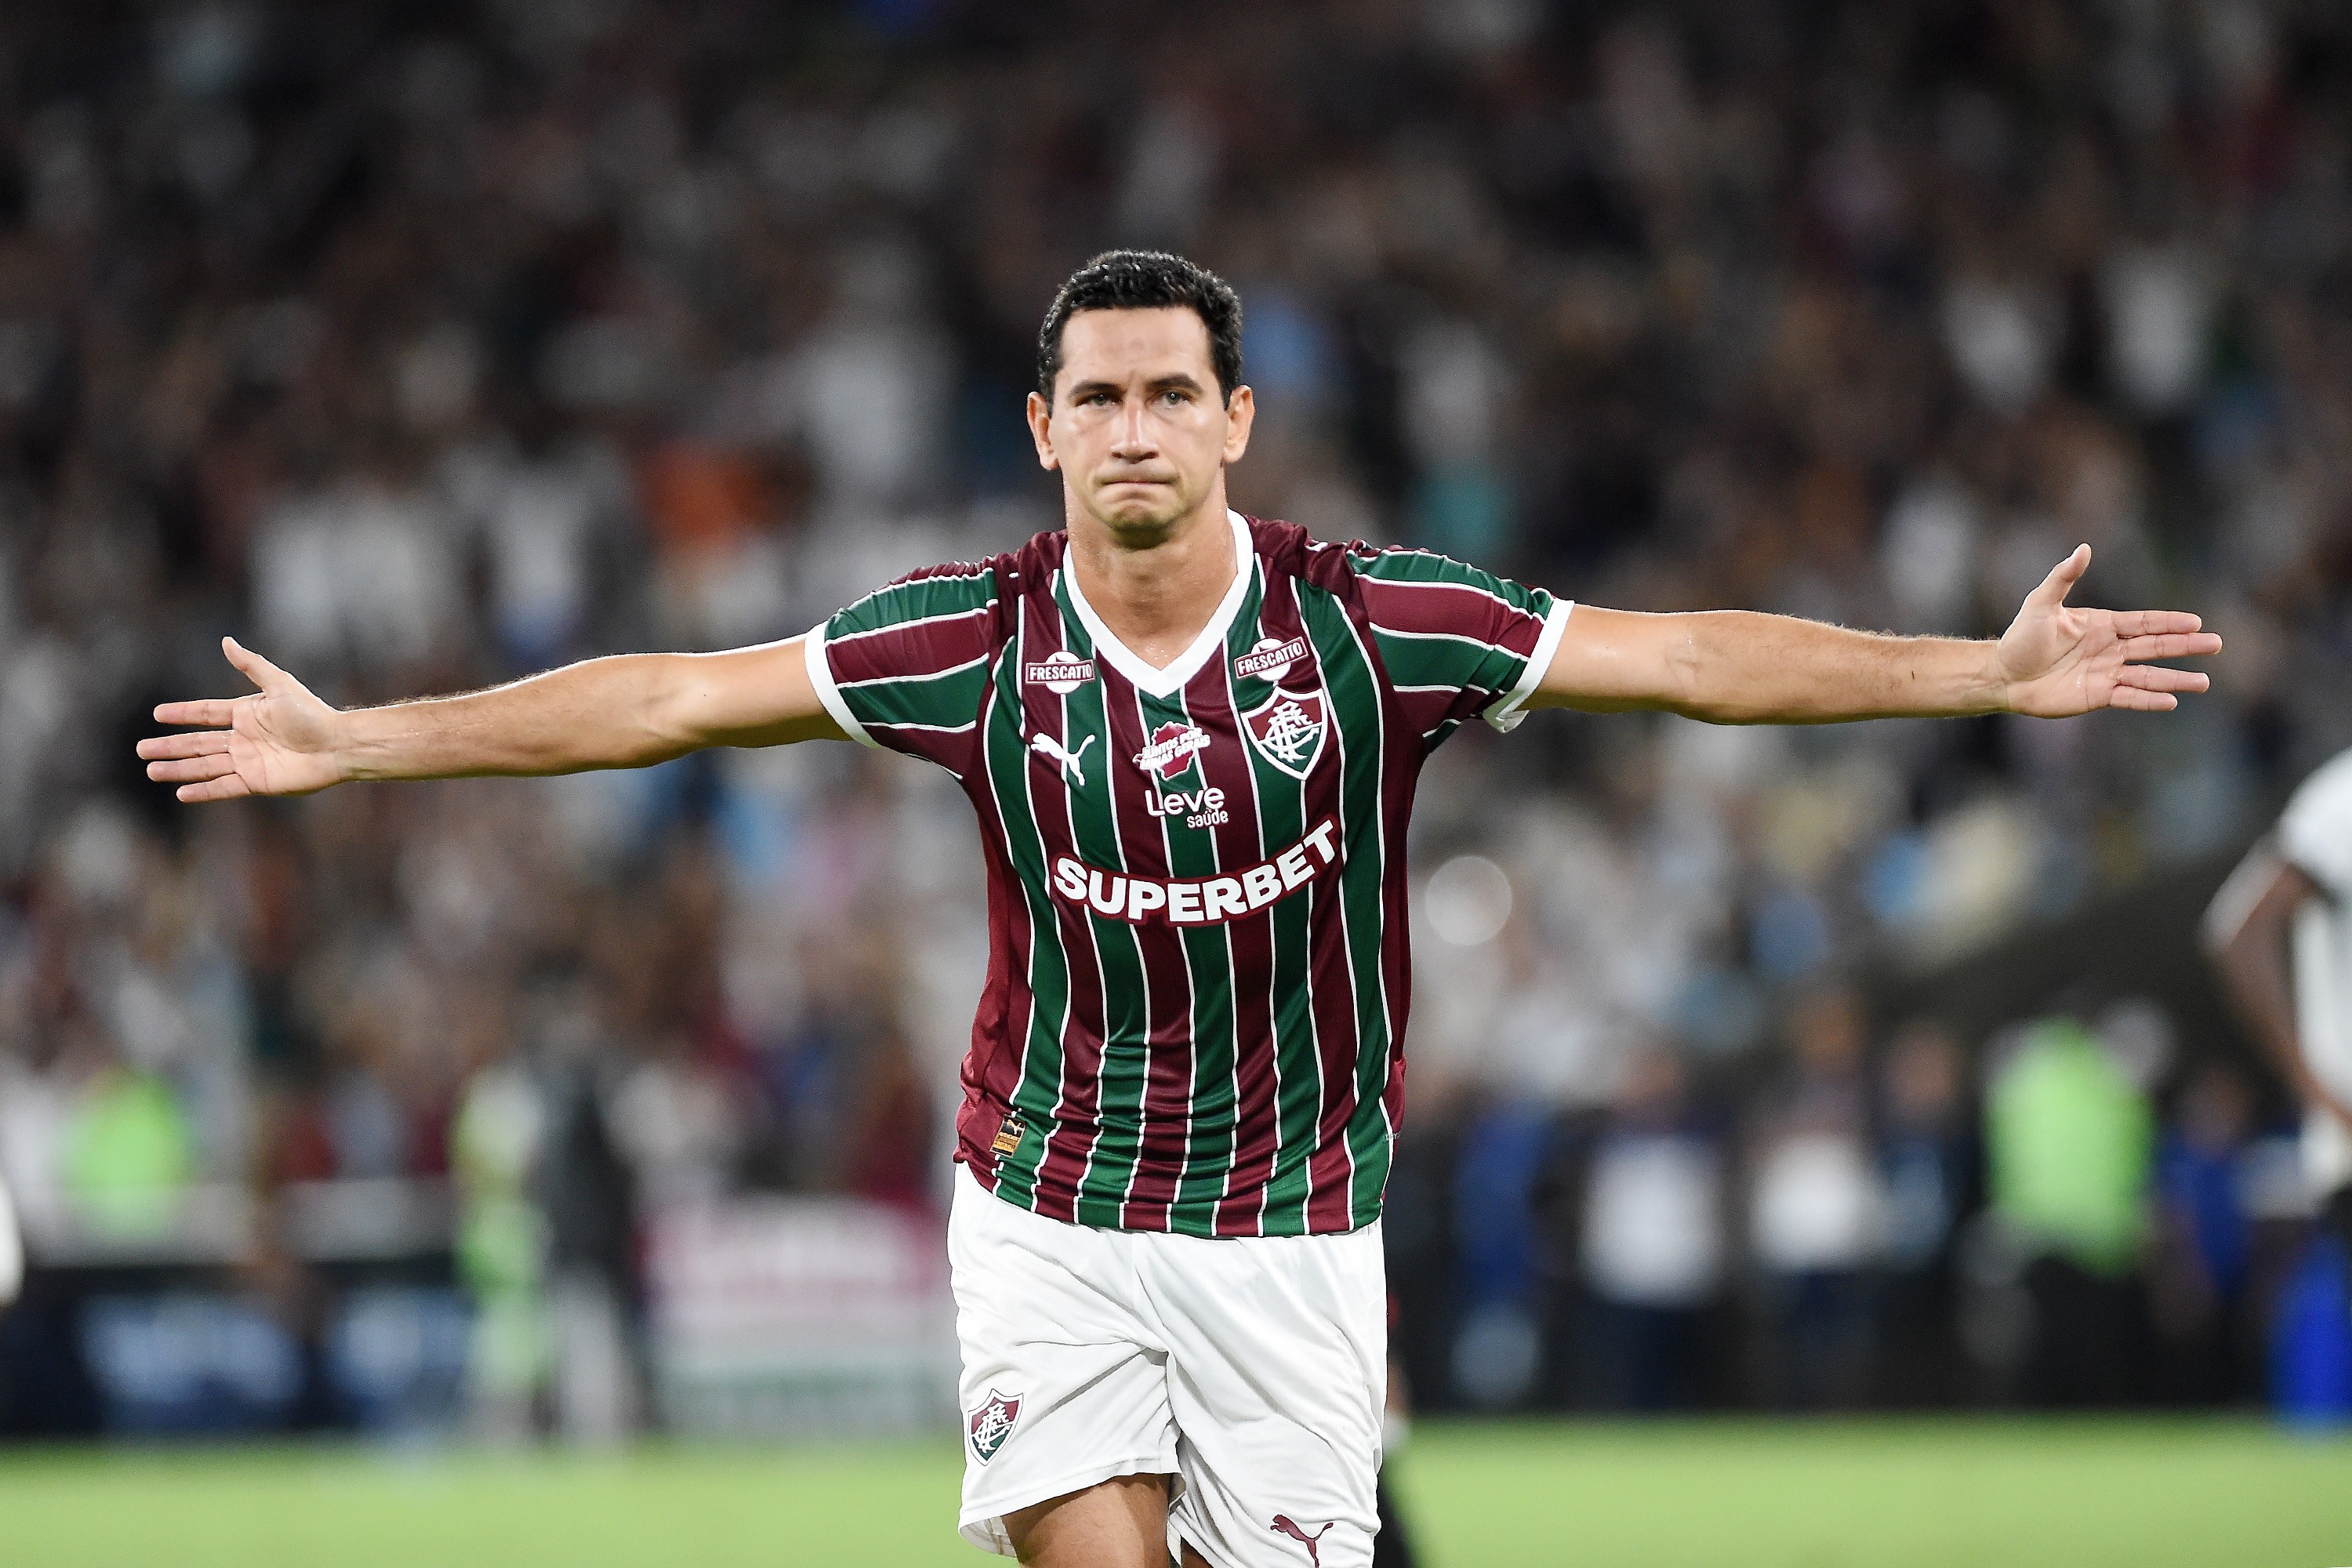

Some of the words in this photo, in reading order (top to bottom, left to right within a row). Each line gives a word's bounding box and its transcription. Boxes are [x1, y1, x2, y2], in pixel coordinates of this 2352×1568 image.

[1029, 663, 1092, 681] FRESCATTO
[1237, 641, 1303, 674] FRESCATTO
[1142, 737, 1178, 759] JUNTOS
[1180, 728, 1202, 744] POR
[1140, 750, 1174, 769] MINAS
[1145, 787, 1225, 816] Leve
[1186, 808, 1229, 829] saúde
[1053, 819, 1335, 922] SUPERBET
